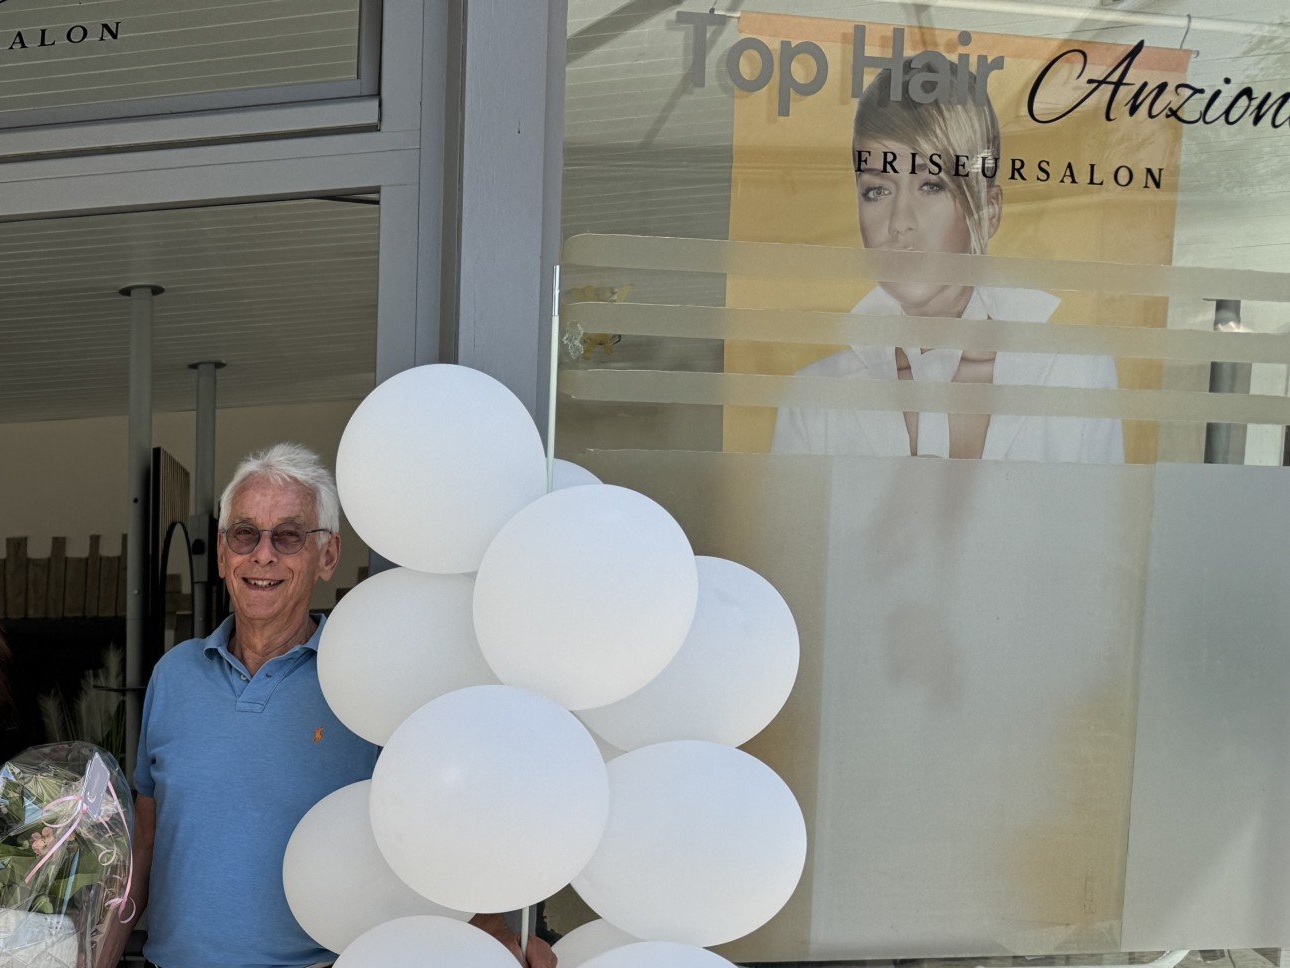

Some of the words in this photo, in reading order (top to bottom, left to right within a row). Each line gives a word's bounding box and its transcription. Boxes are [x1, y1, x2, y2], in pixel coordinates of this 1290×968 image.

[676, 10, 828, 117] Top
[851, 24, 1005, 105] Hair
[855, 149, 1164, 189] FRISEURSALON
